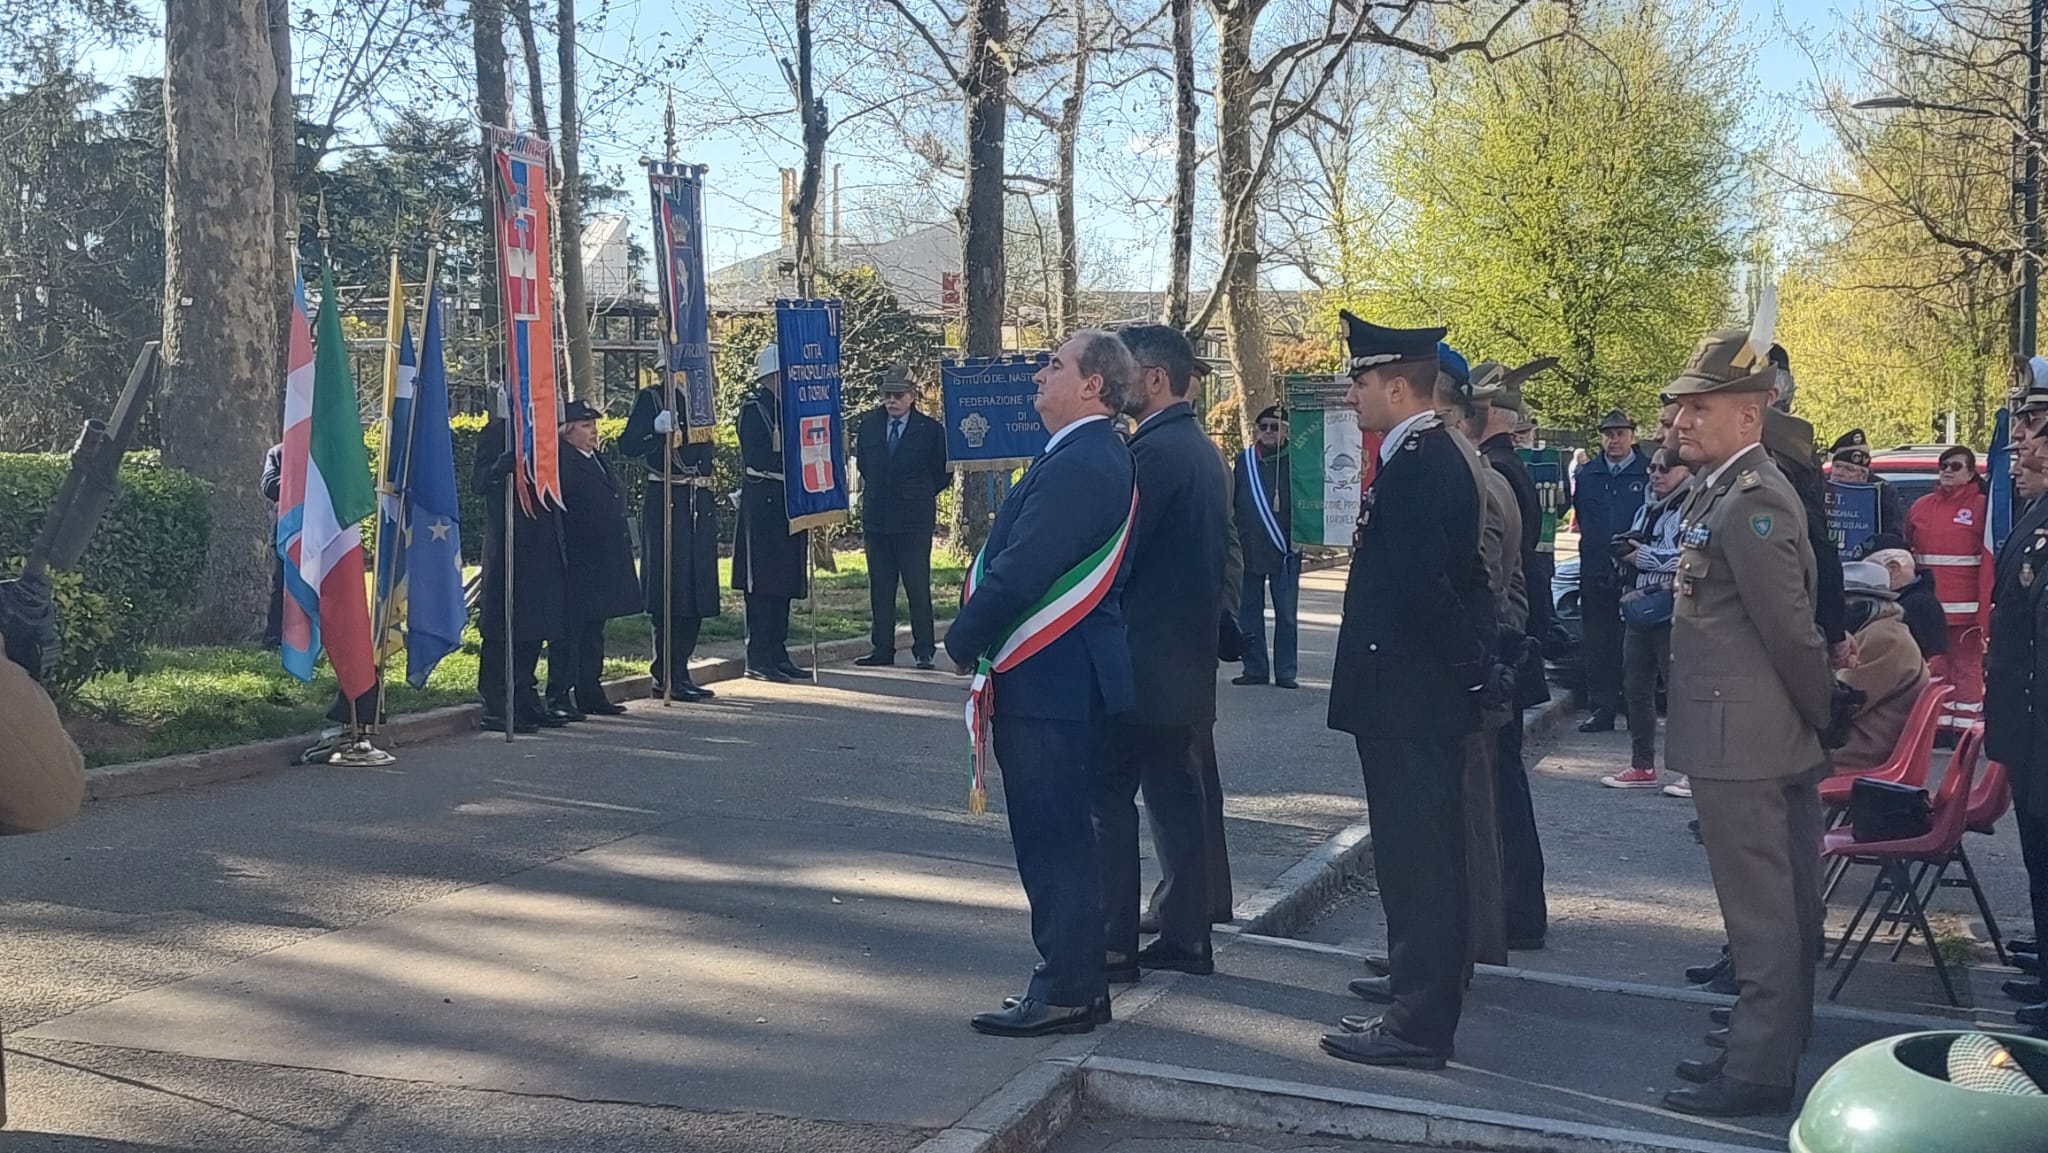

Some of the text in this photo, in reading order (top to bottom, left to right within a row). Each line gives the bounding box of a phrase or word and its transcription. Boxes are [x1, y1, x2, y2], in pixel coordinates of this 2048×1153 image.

[788, 363, 840, 381] METROPOLITANA
[953, 374, 991, 385] ISTITUTO
[992, 374, 1007, 384] DEL
[800, 386, 807, 402] DI
[960, 394, 1023, 407] FEDERAZIONE
[1018, 411, 1027, 421] DI
[1006, 422, 1040, 433] TORINO
[1824, 492, 1845, 505] E.T.
